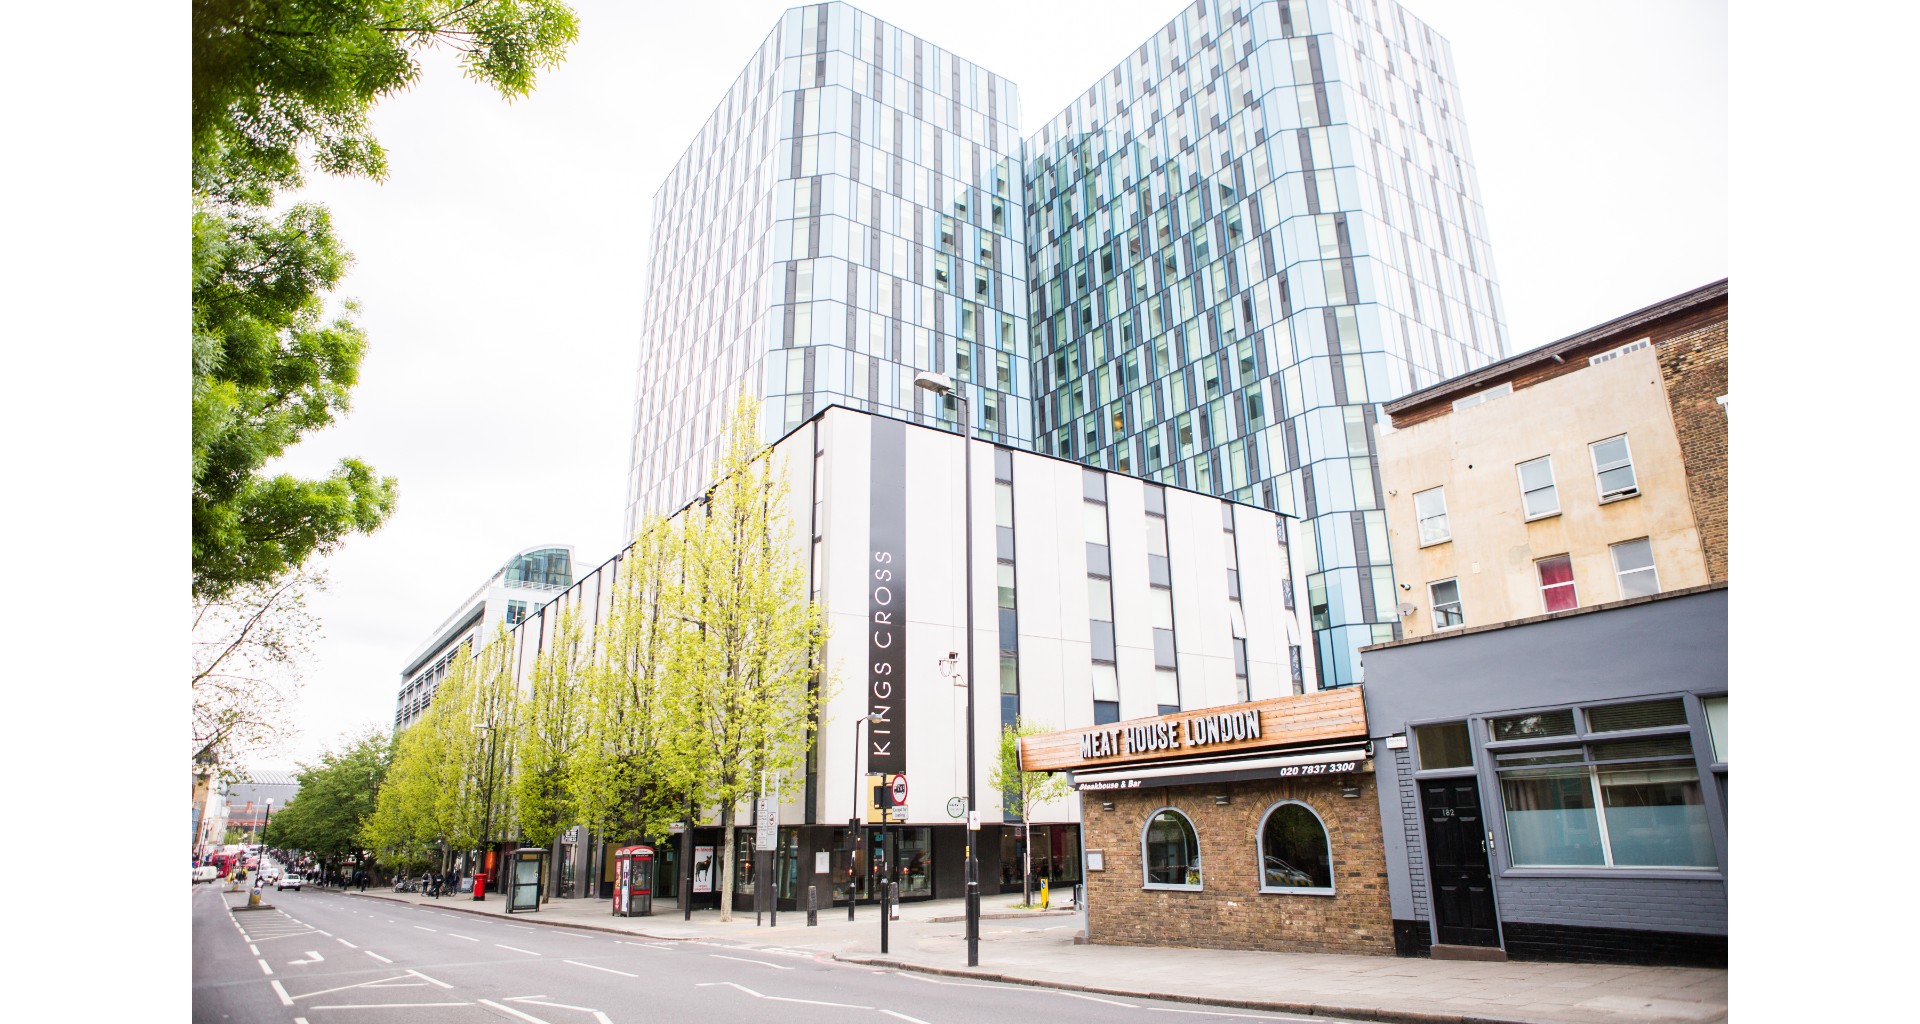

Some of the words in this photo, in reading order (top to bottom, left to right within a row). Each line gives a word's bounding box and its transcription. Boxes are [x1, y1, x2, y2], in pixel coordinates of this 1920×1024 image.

[874, 551, 892, 649] CROSS
[873, 662, 892, 756] KINGS
[1080, 729, 1122, 759] MEAT
[1126, 721, 1180, 754] HOUSE
[1184, 709, 1261, 747] LONDON
[1078, 782, 1120, 791] Steakhouse
[1120, 780, 1127, 788] &
[1128, 779, 1142, 788] Bar
[1280, 766, 1299, 777] 020
[1301, 764, 1327, 775] 7837
[1329, 762, 1356, 773] 3300
[1442, 808, 1455, 817] 182
